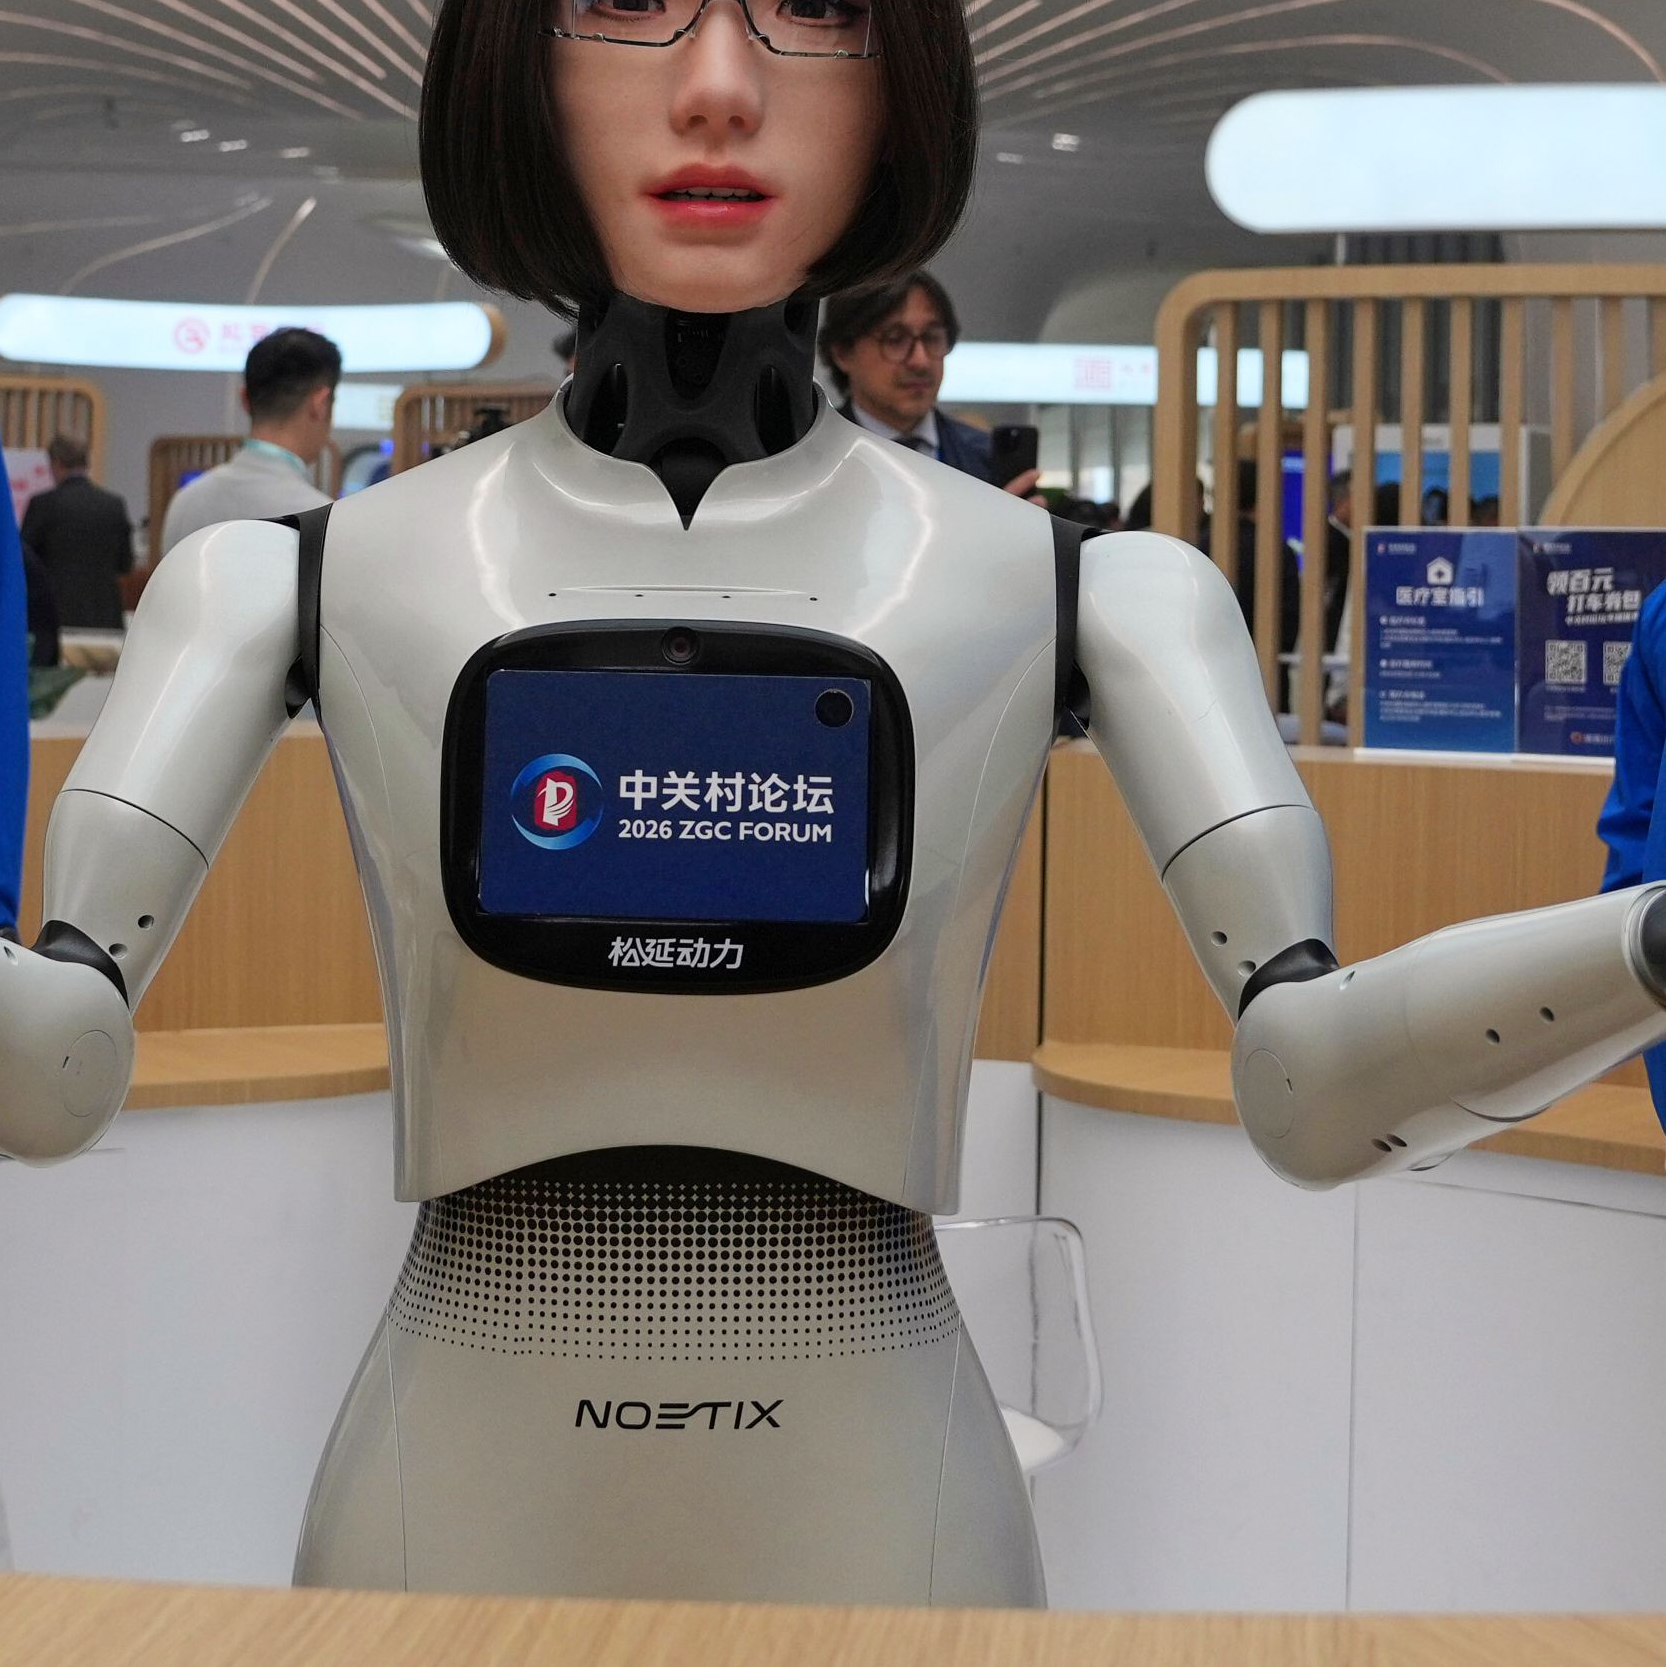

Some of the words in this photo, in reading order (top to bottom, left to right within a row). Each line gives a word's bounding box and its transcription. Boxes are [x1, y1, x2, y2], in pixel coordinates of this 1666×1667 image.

[619, 770, 834, 814] 中关村论坛
[618, 819, 672, 840] 2026
[679, 820, 731, 841] ZGC
[739, 821, 832, 843] FORUM
[608, 937, 743, 969] 松延动力
[575, 1399, 784, 1430] NOETIX
